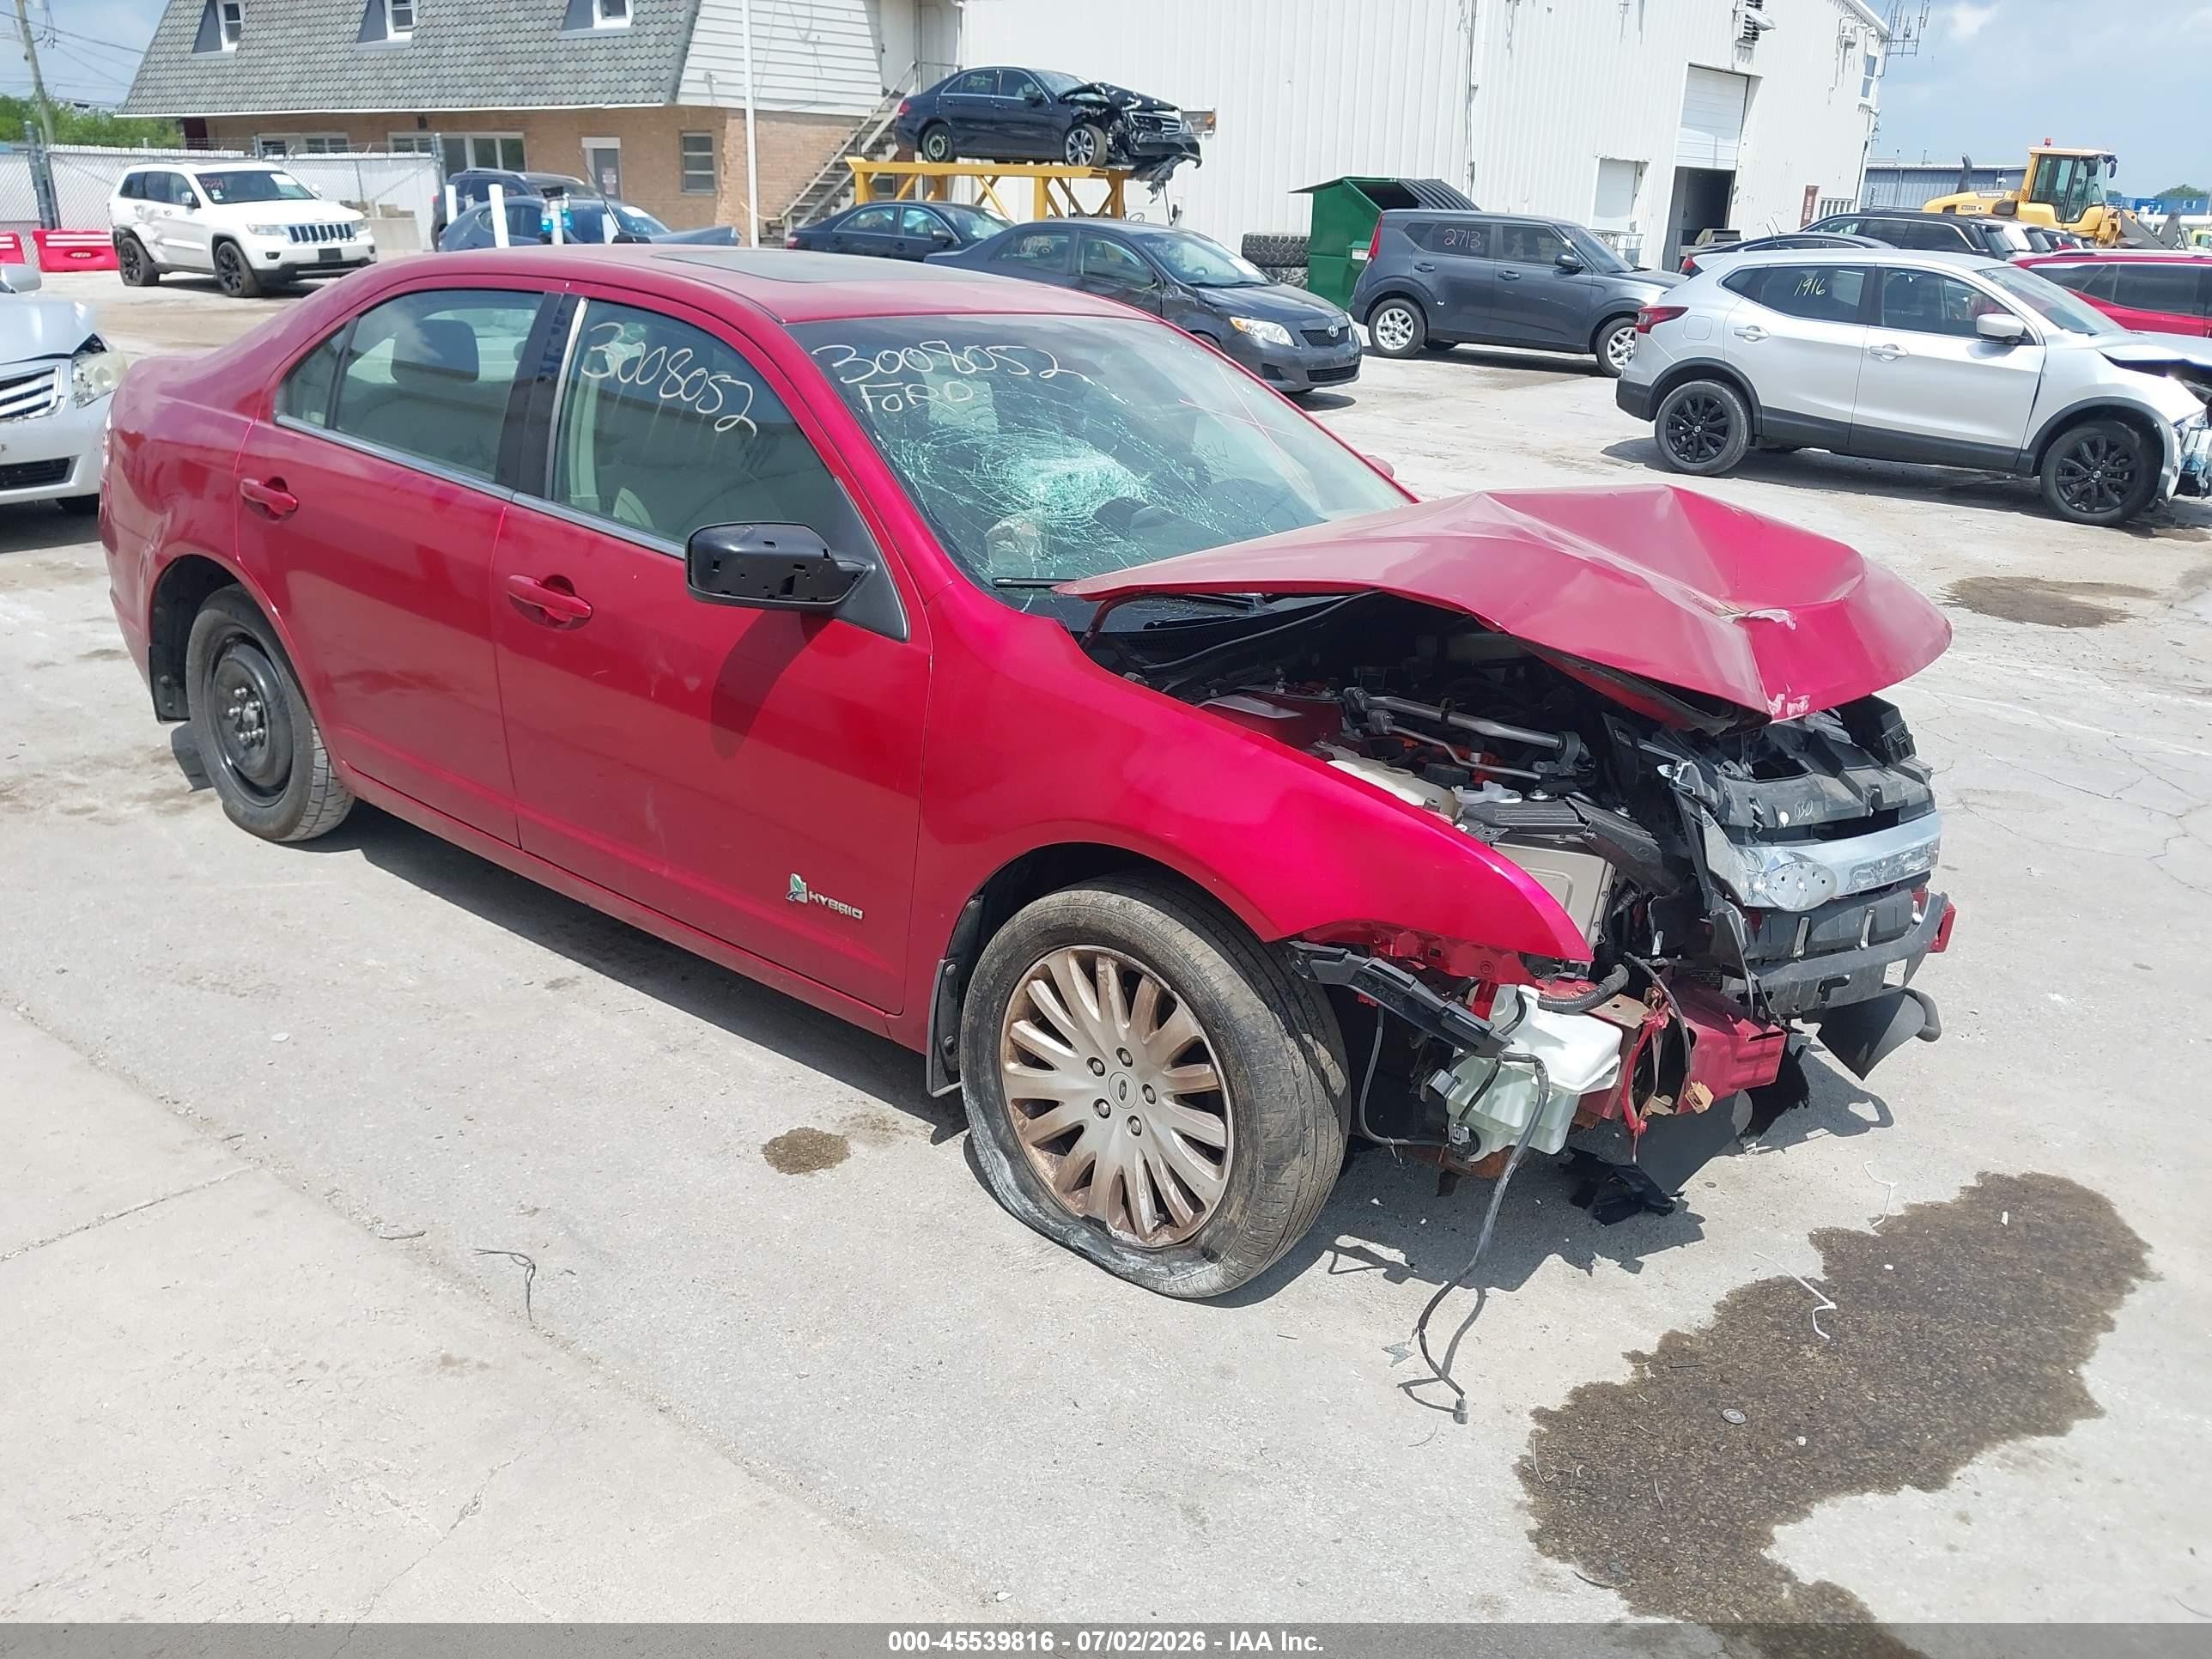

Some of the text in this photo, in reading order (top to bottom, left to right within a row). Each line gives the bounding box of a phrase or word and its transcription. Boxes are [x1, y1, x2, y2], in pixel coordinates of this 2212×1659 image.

[1444, 228, 1480, 248] 2713
[1794, 277, 1826, 297] 1916
[811, 340, 1096, 385] 3008052
[581, 322, 757, 437] 3008052
[809, 890, 863, 921] HYBRID
